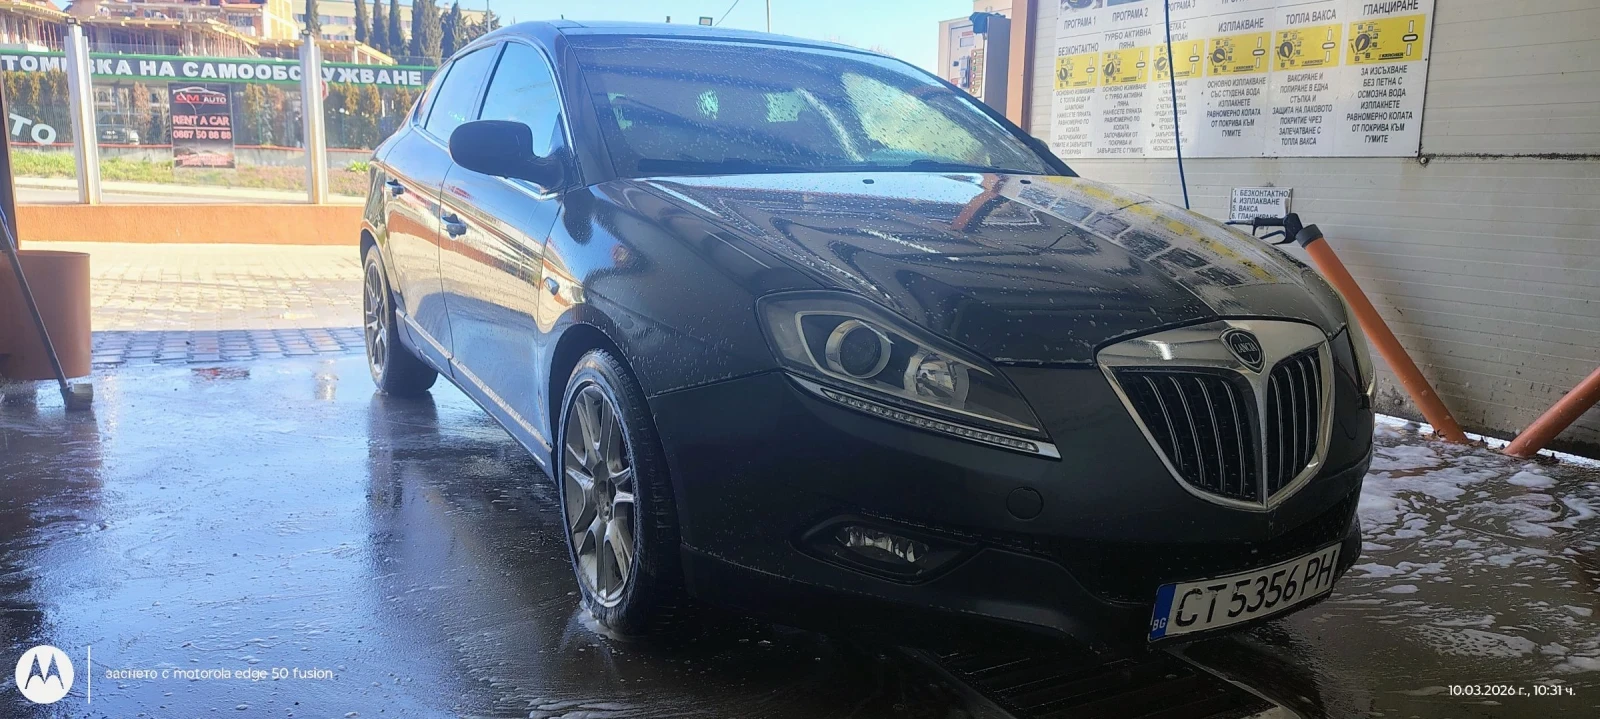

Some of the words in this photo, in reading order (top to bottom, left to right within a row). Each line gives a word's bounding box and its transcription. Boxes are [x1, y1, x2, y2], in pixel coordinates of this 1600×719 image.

[1363, 0, 1419, 16] ГЛАНЦИРАНЕ
[1112, 8, 1143, 22] ПРОГРАМА
[1286, 12, 1310, 25] ТОПЛА
[1312, 9, 1337, 22] ВАКСА
[1064, 17, 1092, 30] ПРОГРАМА
[1218, 18, 1264, 32] ИЗПЛАКВАНЕ
[1104, 31, 1124, 42] ТУРБО
[1124, 28, 1152, 39] АКТИВНА
[1058, 42, 1099, 56] БЕЗКОНТАКТНО
[1119, 41, 1135, 50] ПЯНА
[140, 60, 175, 78] НА
[182, 62, 422, 86] САМООБСУЖВАНЕ
[1361, 67, 1368, 76] ЗА
[1370, 65, 1408, 75] ИЗСЪХВАНЕ
[1207, 80, 1232, 88] ОСНОВНО
[1232, 77, 1266, 87] ИЗПЛАКВАНЕ
[1287, 73, 1318, 82] ВАКСИРАНЕ
[1363, 79, 1375, 87] БЕЗ
[1376, 77, 1397, 86] ПЕТНА
[1210, 90, 1222, 98] СЪС
[1222, 89, 1245, 97] СТУДЕНА
[1246, 88, 1260, 96] ВОДА
[1280, 84, 1308, 93] ПОЛИРАНЕ
[1314, 83, 1329, 92] ЕДНА
[1358, 90, 1387, 98] ОСМОЗНА
[1388, 88, 1406, 98] ВОДА
[1218, 98, 1251, 107] ИЗПЛАКНЕТЕ
[1290, 95, 1311, 104] СТЪПКА
[1272, 106, 1294, 115] ЗАЩИТА
[1303, 104, 1333, 113] ЛАКОВОТО
[1361, 100, 1400, 110] ИЗПЛАКНЕТЕ
[1206, 110, 1240, 118] РАВНОМЕРНО
[1241, 108, 1261, 116] КОЛАТА
[1347, 112, 1388, 121] РАВНОМЕРНО
[1388, 111, 1413, 120] КОЛАТА
[172, 115, 198, 125] RENT
[200, 116, 208, 125] A
[209, 116, 230, 126] CAR
[1218, 119, 1242, 127] ПОКРИВА
[1280, 116, 1308, 125] ПОКРИТИЕ
[1308, 116, 1322, 124] ЧРЕЗ
[1279, 127, 1316, 136] ЗАПЕЧАТВАНЕ
[1352, 124, 1360, 132] ОТ
[1361, 124, 1389, 132] ПОКРИВА
[1390, 123, 1405, 131] КЪМ
[1281, 138, 1298, 146] ТОПЛА
[1365, 135, 1389, 143] ГУМИТЕ
[1240, 190, 1288, 198] БЕЗКОНТАКТНО
[1175, 584, 1227, 627] CT
[1227, 565, 1299, 618] 5356
[1300, 550, 1336, 596] PH
[1152, 617, 1166, 631] BG
